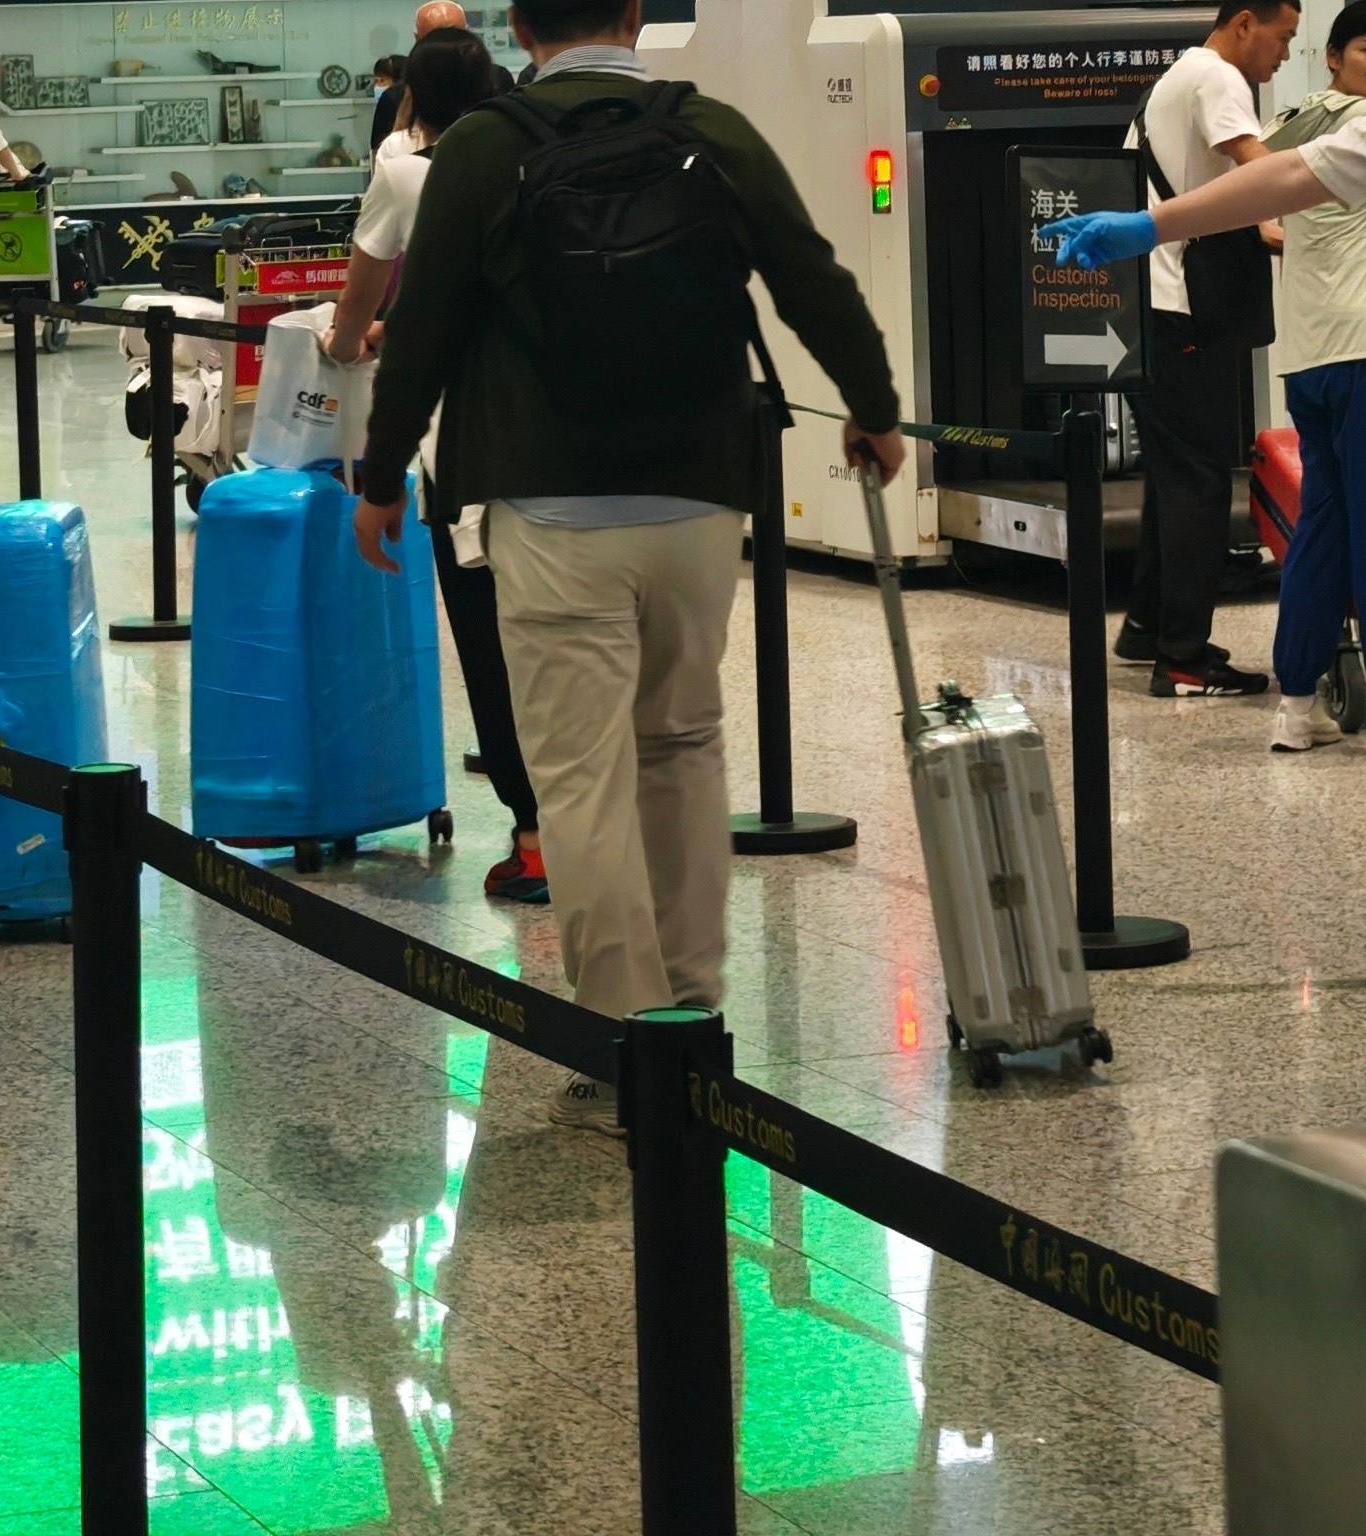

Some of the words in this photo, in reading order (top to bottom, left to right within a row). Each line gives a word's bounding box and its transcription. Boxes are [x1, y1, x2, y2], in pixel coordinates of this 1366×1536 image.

[1031, 76, 1052, 86] take
[1054, 76, 1075, 85] care
[1087, 75, 1112, 86] your
[1030, 188, 1079, 219] 海关
[1032, 264, 1109, 284] Customs
[1033, 287, 1121, 311] Inspection
[297, 389, 327, 409] cdf
[458, 968, 526, 1034] Customs
[708, 1080, 797, 1163] Customs
[1099, 1263, 1221, 1363] Customs
